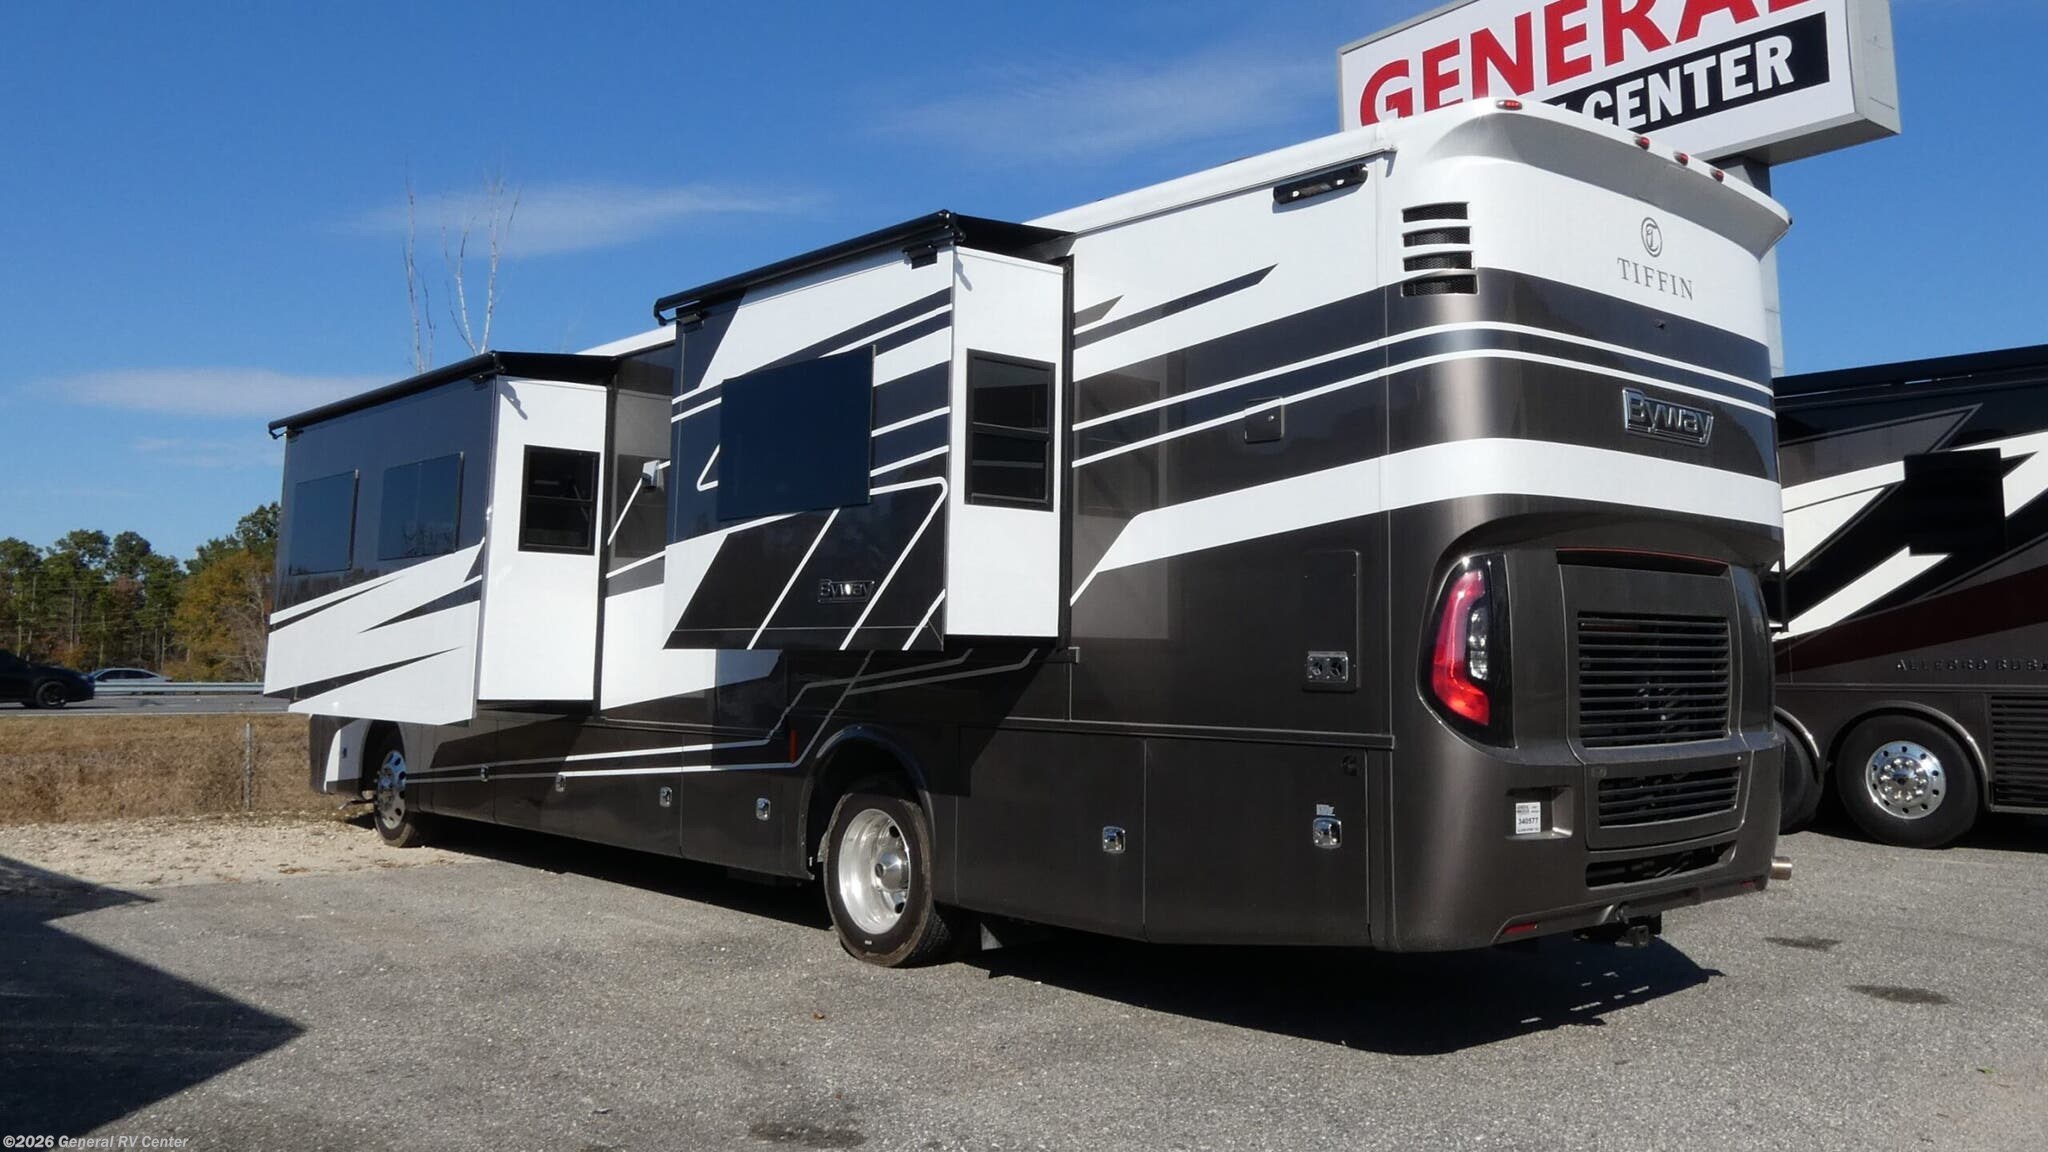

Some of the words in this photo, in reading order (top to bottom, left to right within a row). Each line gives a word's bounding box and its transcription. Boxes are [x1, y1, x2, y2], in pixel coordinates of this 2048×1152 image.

[1360, 0, 1813, 126] GENER
[1581, 35, 1795, 127] CENTER
[1617, 257, 1693, 301] TIFFIN
[1624, 389, 1713, 444] Byway
[819, 580, 873, 601] Byway
